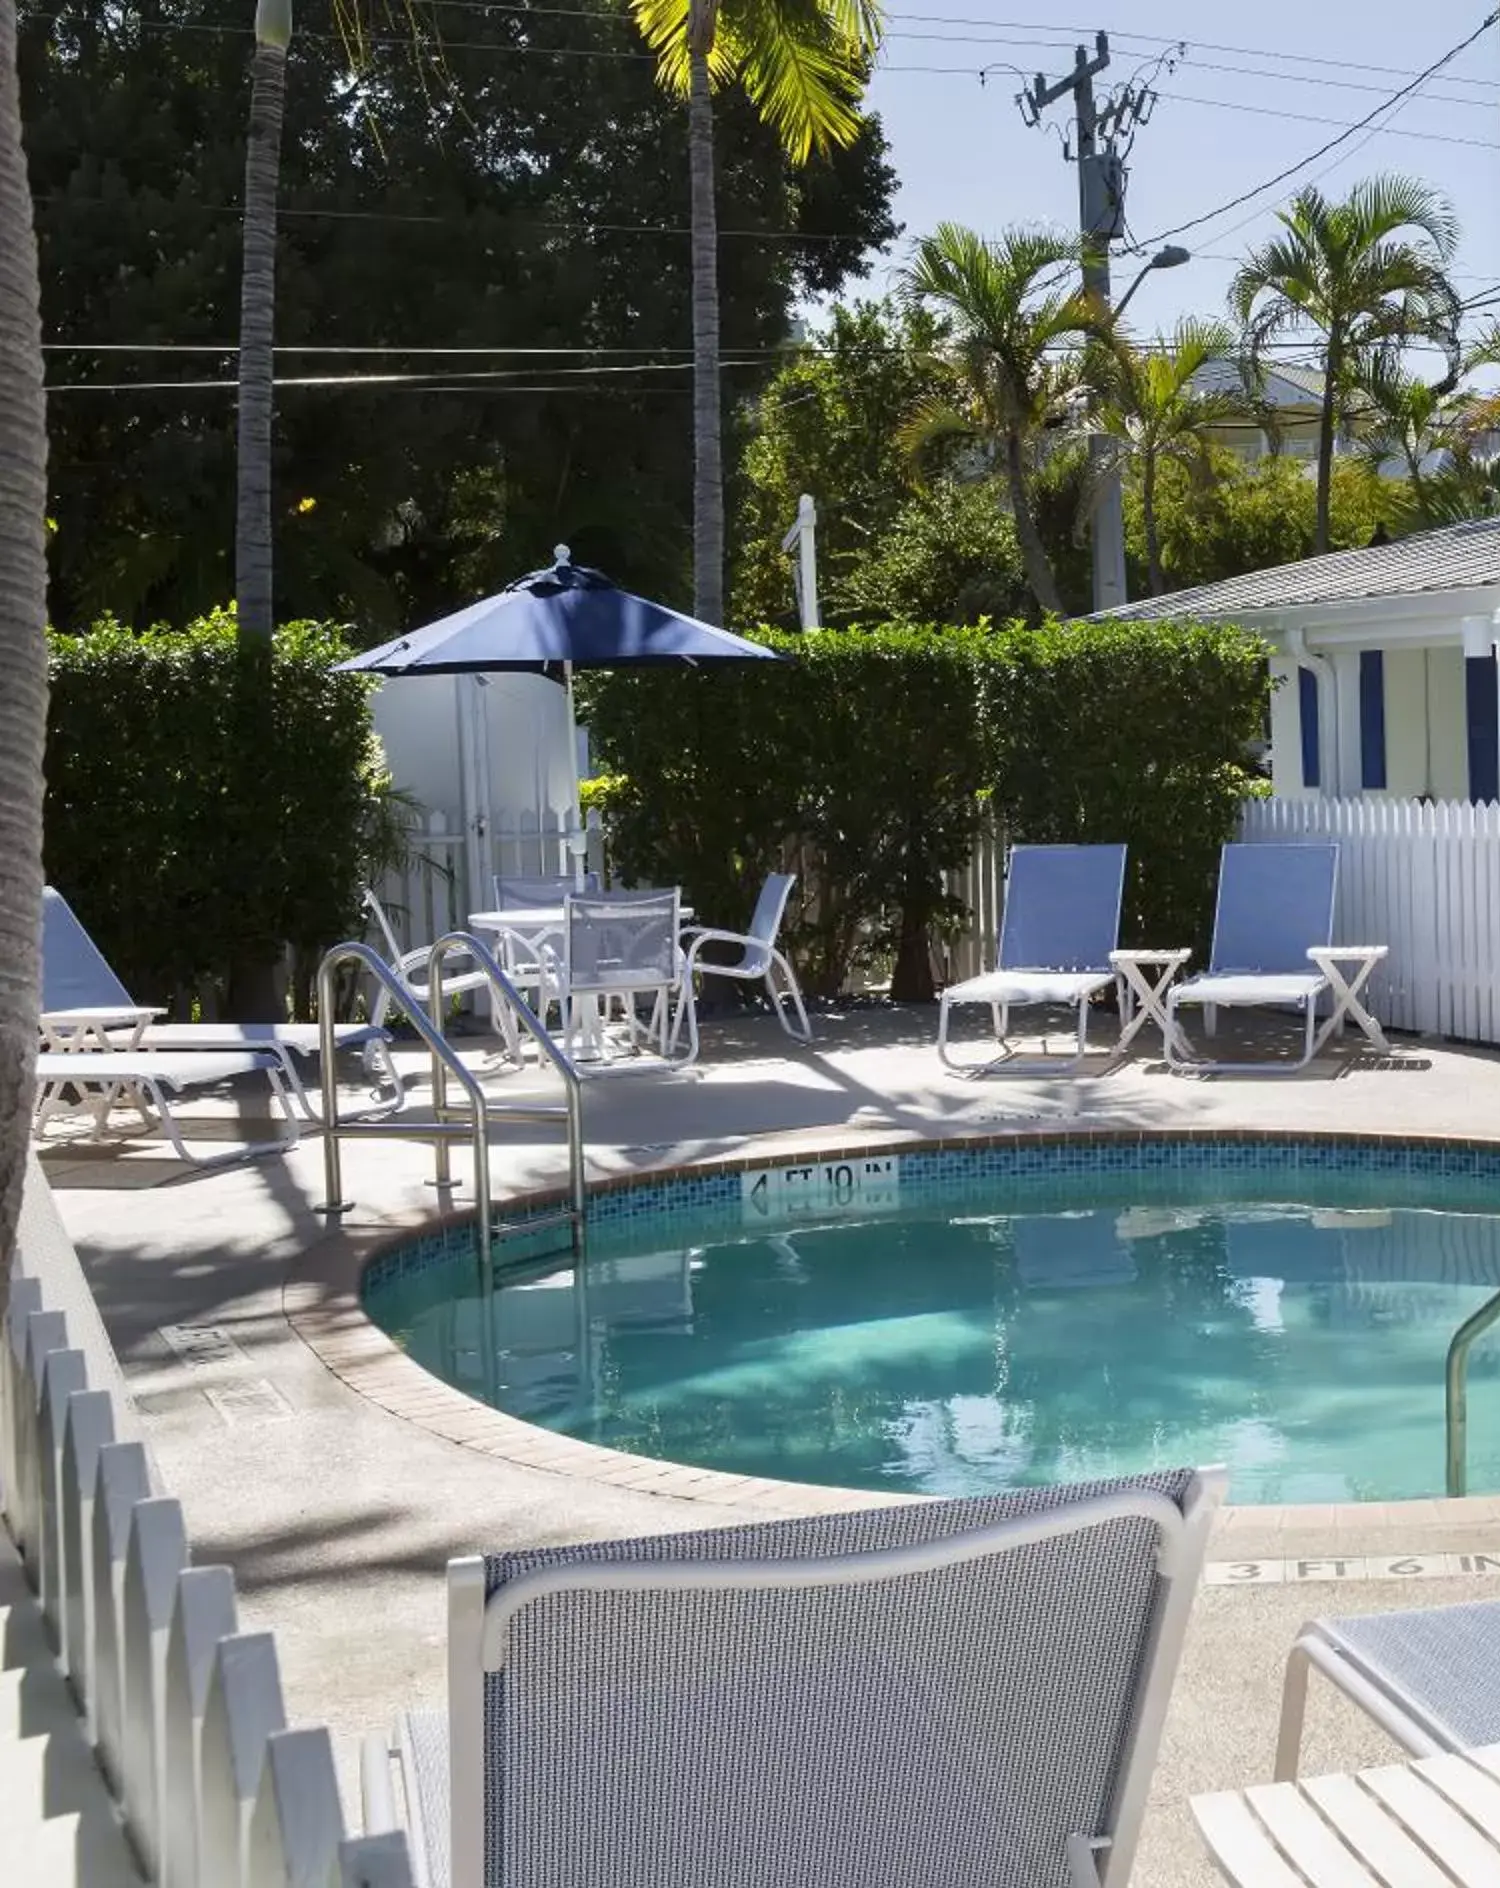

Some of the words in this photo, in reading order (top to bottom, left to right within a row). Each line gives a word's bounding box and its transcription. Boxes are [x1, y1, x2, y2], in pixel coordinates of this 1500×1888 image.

[1226, 1563, 1262, 1580] 3
[1297, 1560, 1354, 1578] FT
[1387, 1557, 1425, 1575] 6
